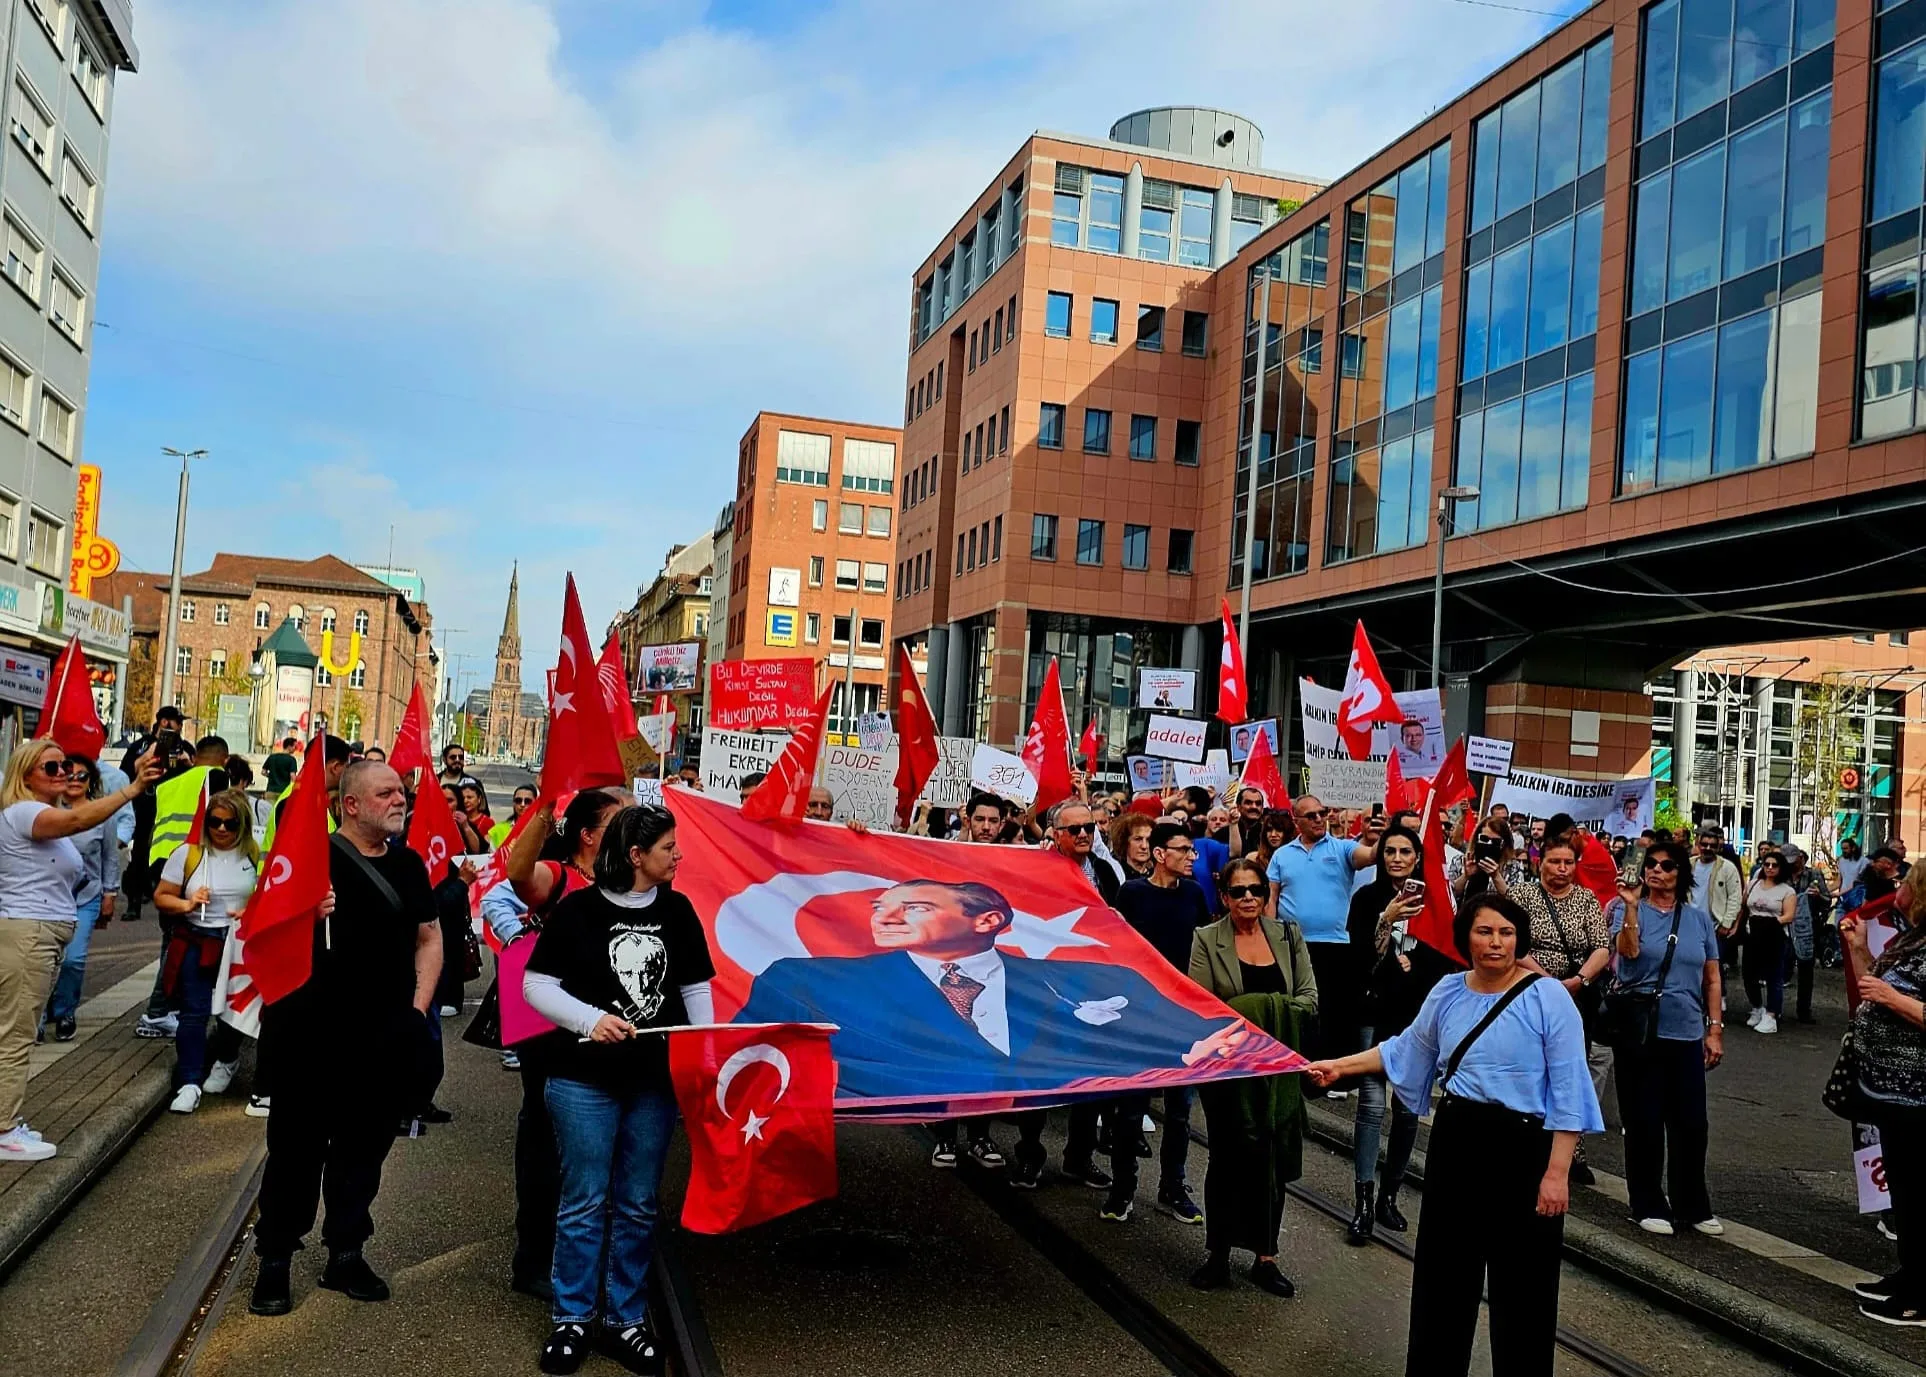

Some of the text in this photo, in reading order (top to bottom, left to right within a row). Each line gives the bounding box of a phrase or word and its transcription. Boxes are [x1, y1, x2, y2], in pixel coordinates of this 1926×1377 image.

[322, 630, 360, 675] U
[1149, 728, 1203, 747] adalet
[1507, 772, 1549, 793] HALKIN
